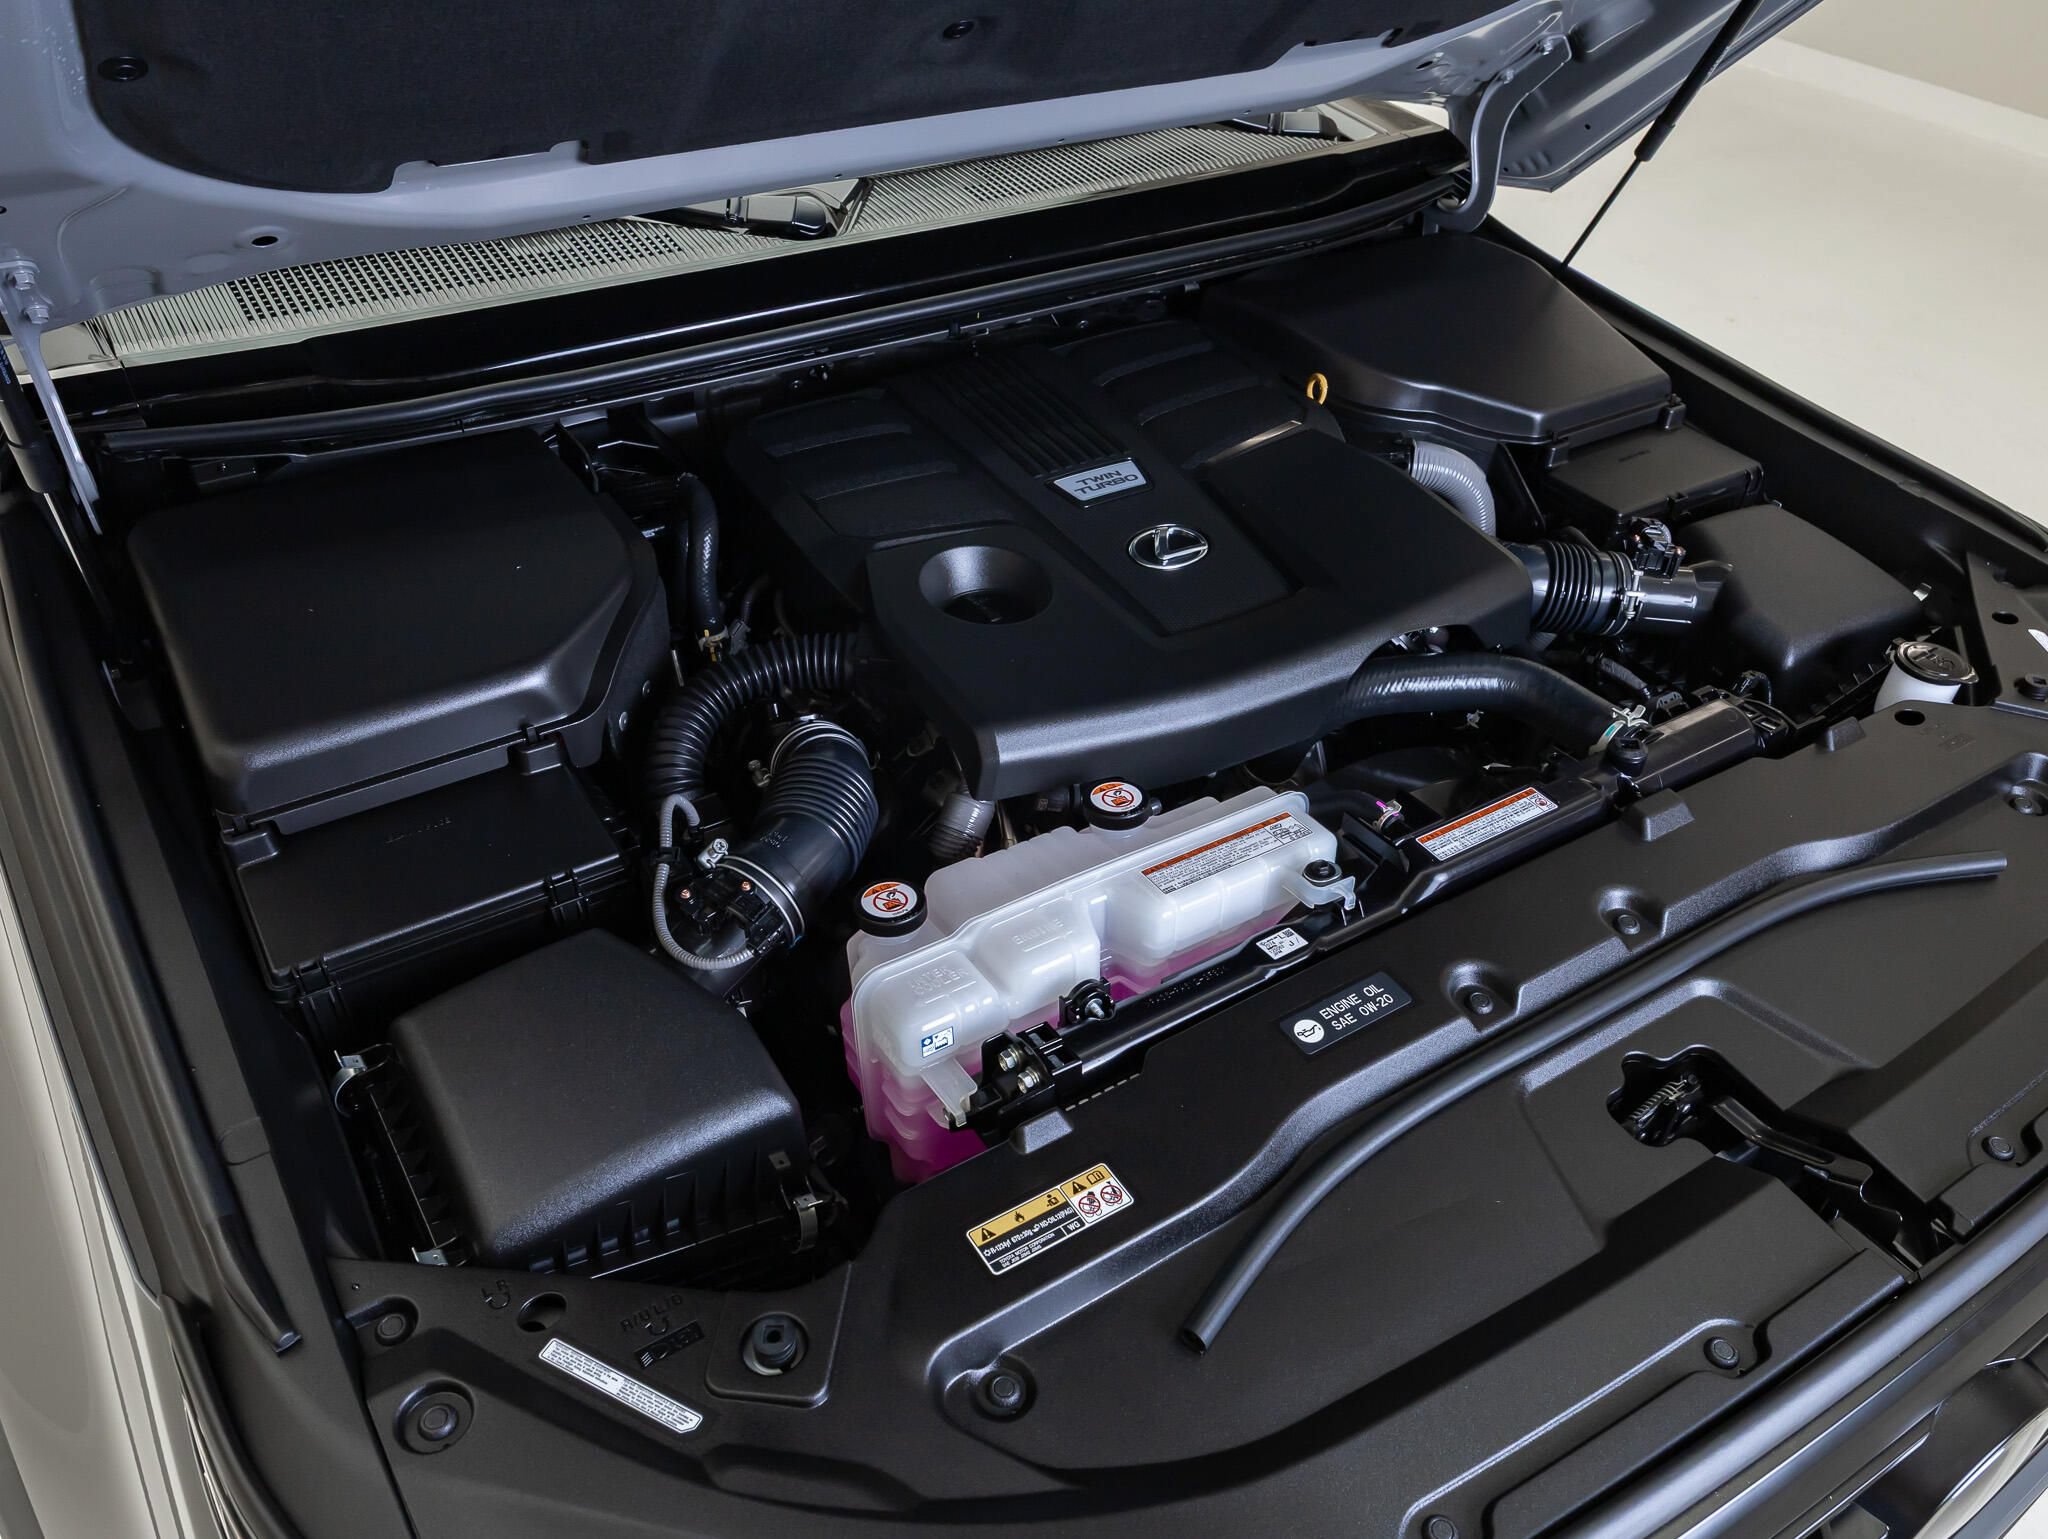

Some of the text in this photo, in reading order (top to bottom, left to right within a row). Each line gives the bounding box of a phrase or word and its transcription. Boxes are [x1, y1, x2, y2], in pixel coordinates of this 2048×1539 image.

[1074, 474, 1139, 495] TURBO
[1076, 470, 1122, 485] TWIN
[1319, 984, 1385, 1020] ENGINE OIL
[1331, 993, 1394, 1031] SAE 0W-20
[1067, 1221, 1080, 1231] WG
[999, 1233, 1054, 1264] TOYOTA MOTOR CORPORATION
